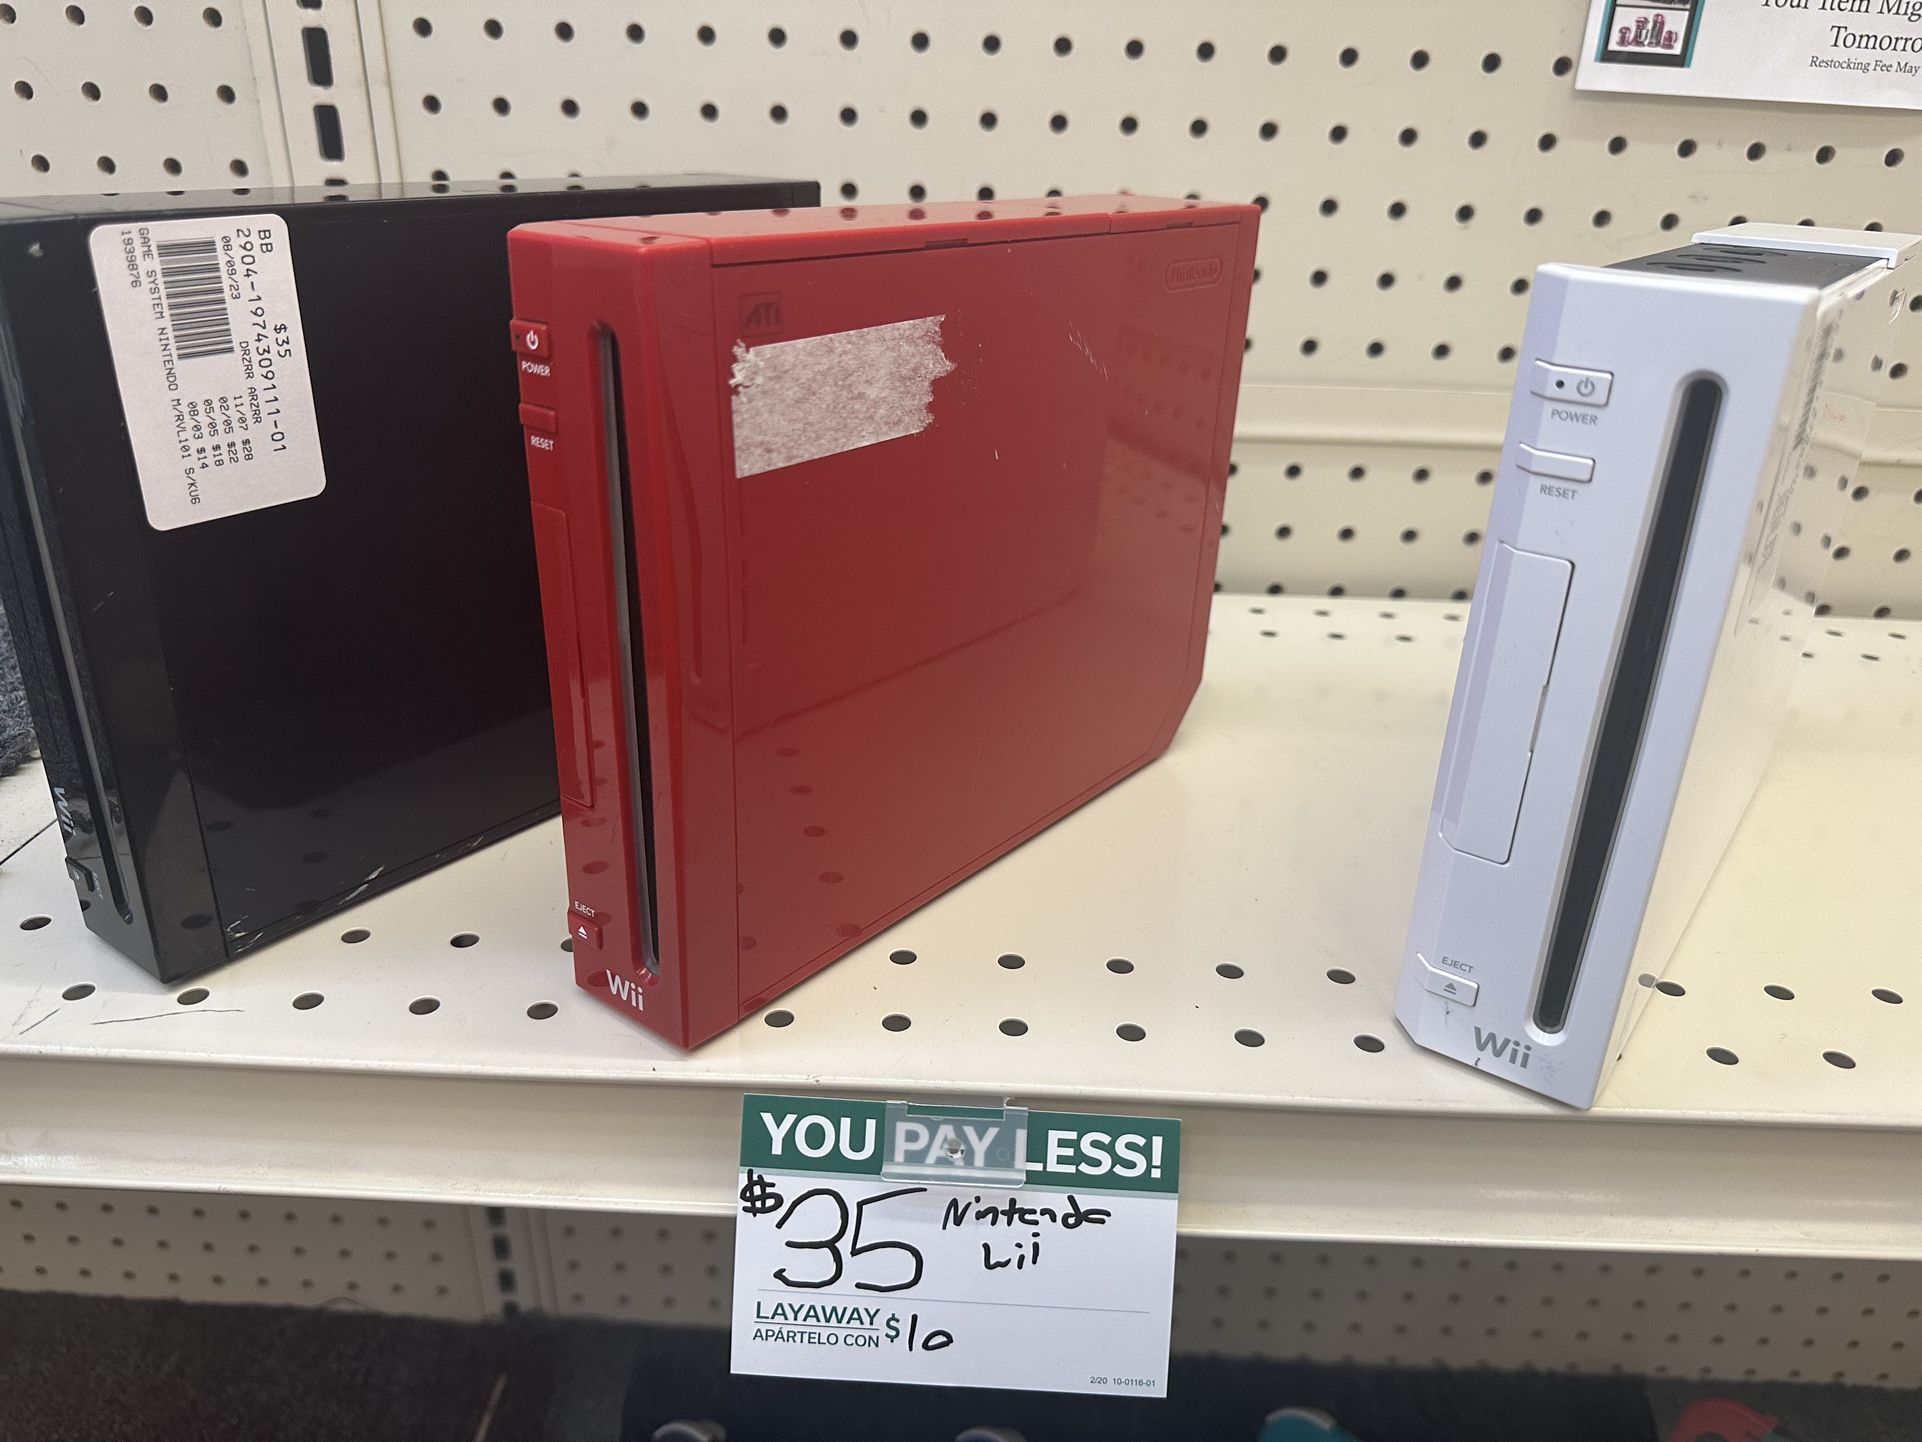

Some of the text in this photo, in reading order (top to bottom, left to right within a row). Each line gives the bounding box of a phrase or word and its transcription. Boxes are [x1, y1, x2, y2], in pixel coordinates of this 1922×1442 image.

[1830, 25, 1922, 53] Tomorro
[1809, 55, 1921, 77] Restocking Fee May
[121, 229, 142, 288] 1939876
[257, 229, 273, 254] BB
[221, 235, 241, 300] 08/09/23
[138, 227, 154, 261] GAME
[146, 270, 165, 320] SYSTEM
[157, 326, 179, 391] NINTENDO
[170, 398, 192, 460] M/RVL101
[236, 227, 287, 452] 2904-1974309111-01
[274, 323, 292, 358] $35
[521, 360, 551, 377] POWER
[247, 386, 262, 425] ARZRR
[1550, 408, 1598, 426] POWER
[187, 401, 209, 470] 08/03 $14
[203, 399, 224, 467] 05/05 $18
[218, 396, 239, 464] 02/05 $22
[233, 395, 254, 461] 11/07 $28
[530, 435, 554, 451] RESET
[1539, 483, 1578, 500] RESET
[574, 900, 596, 918] EJECT
[1441, 955, 1474, 974] EJECT
[605, 968, 644, 1011] Wii
[1473, 1025, 1532, 1069] Wii
[759, 1111, 1164, 1179] YOU PAY LESS!
[739, 1169, 927, 1293] $35
[755, 1300, 881, 1326] LAYAWAY
[752, 1326, 839, 1346] APÁRTELO
[843, 1333, 879, 1348] CON
[1090, 1376, 1156, 1387] 2/20 10-0116-01
